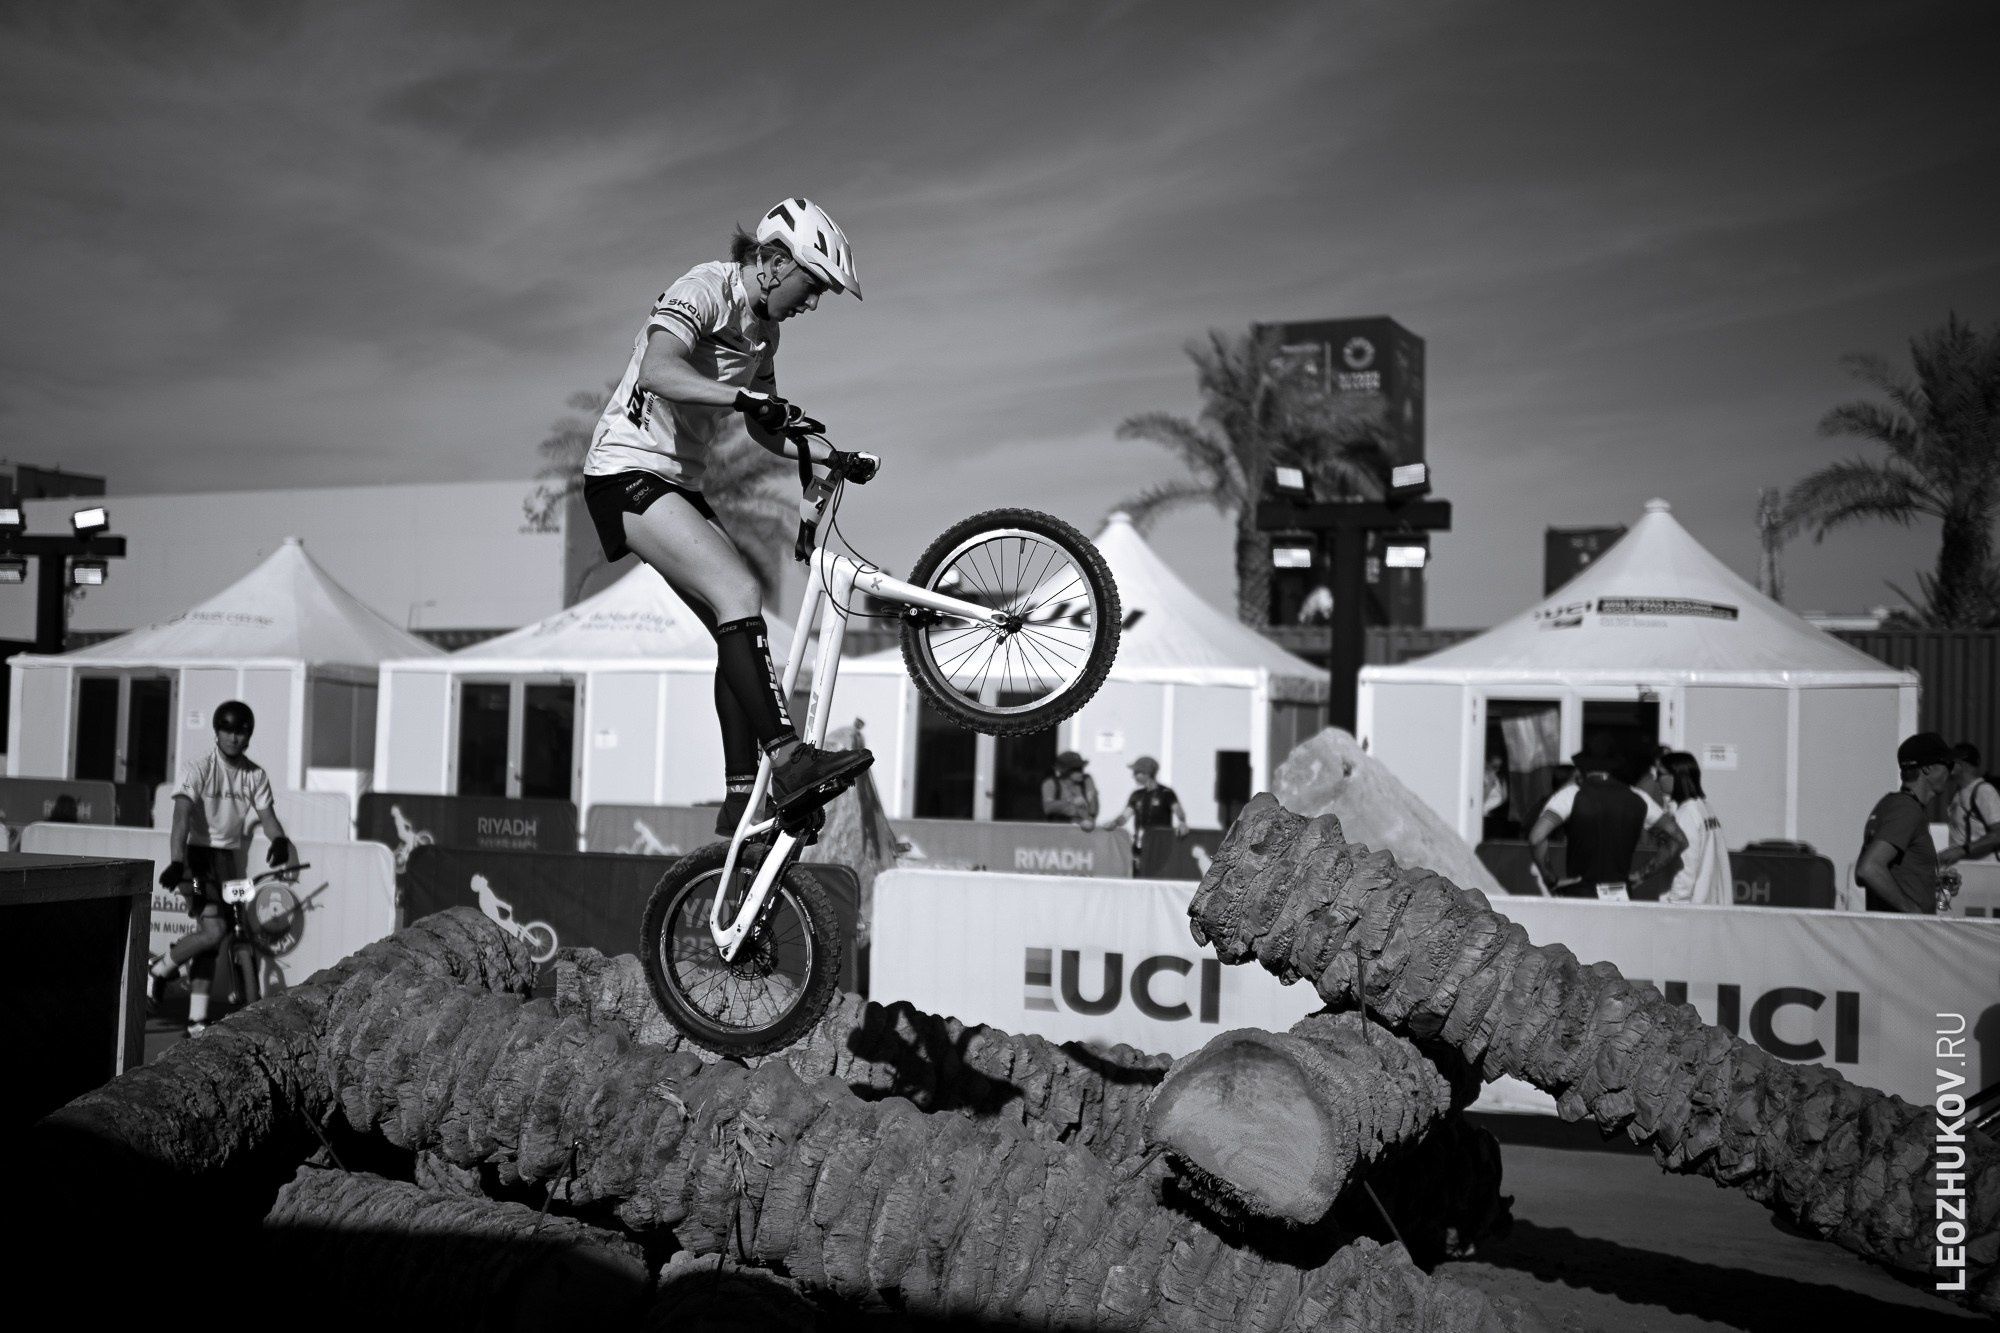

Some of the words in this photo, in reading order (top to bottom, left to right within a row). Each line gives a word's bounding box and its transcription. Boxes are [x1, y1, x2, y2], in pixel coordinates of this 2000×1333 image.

[815, 499, 826, 516] 4
[477, 816, 538, 837] RIYADH
[1014, 848, 1095, 871] RIYADH
[1061, 949, 1220, 1024] UCI
